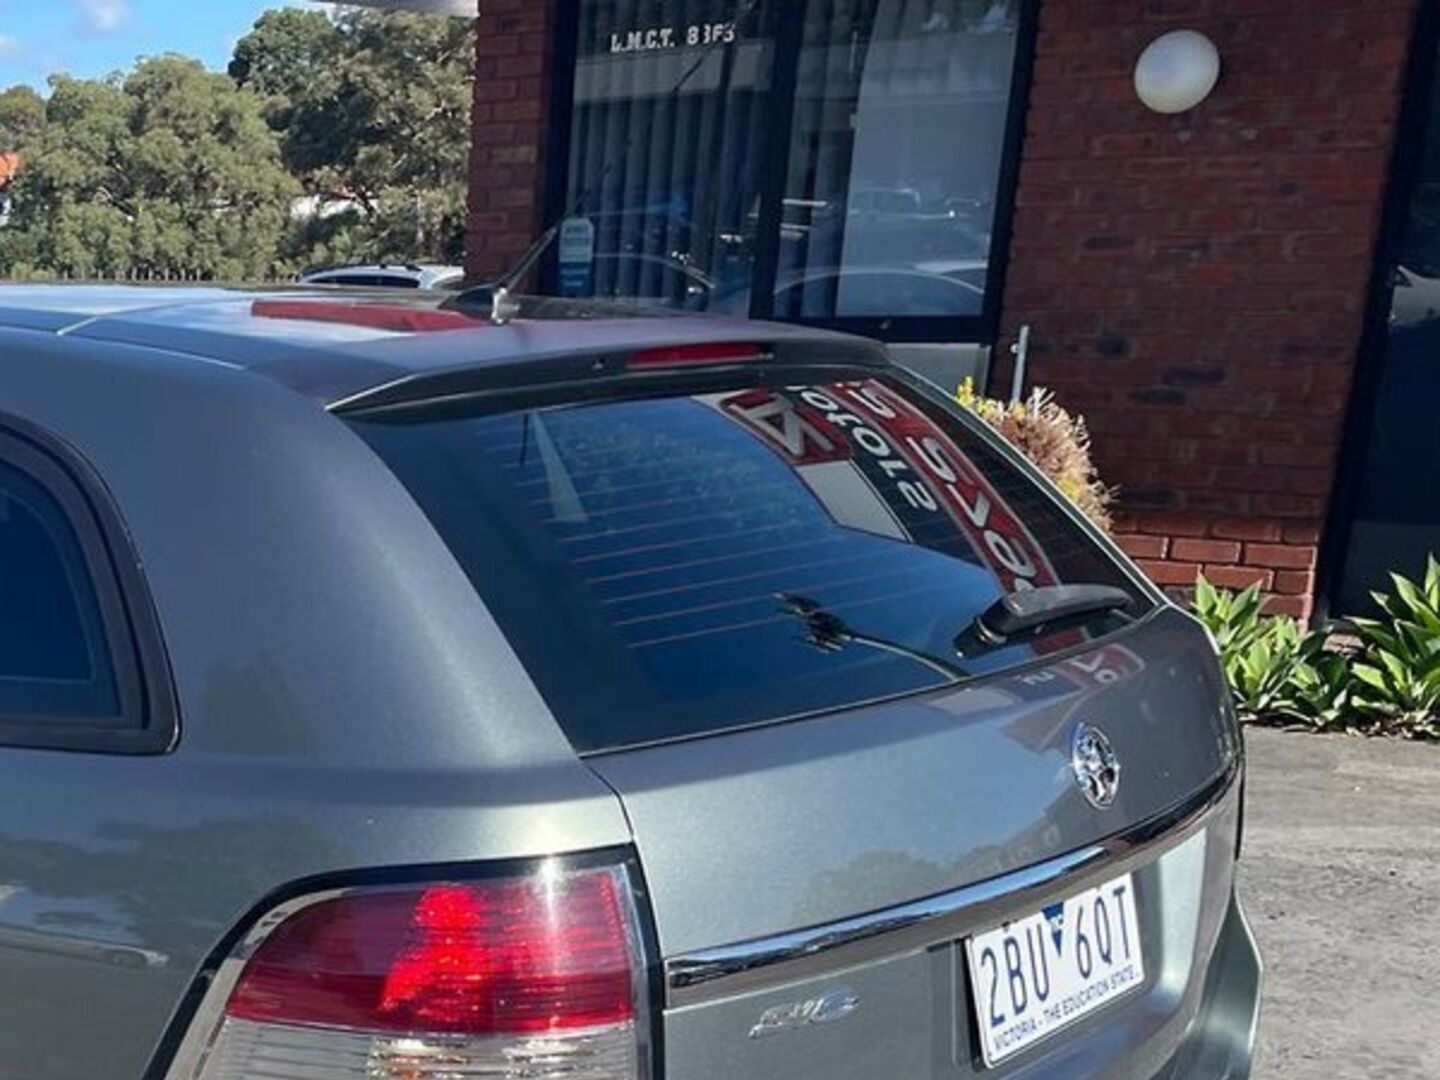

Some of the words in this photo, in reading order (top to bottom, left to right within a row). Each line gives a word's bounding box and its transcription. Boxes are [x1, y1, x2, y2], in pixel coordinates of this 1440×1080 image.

[993, 1019, 1038, 1050] VICTORIA
[1043, 1002, 1062, 1020] THE
[1062, 979, 1110, 1017] EDUCATION
[1110, 963, 1136, 990] STATE
